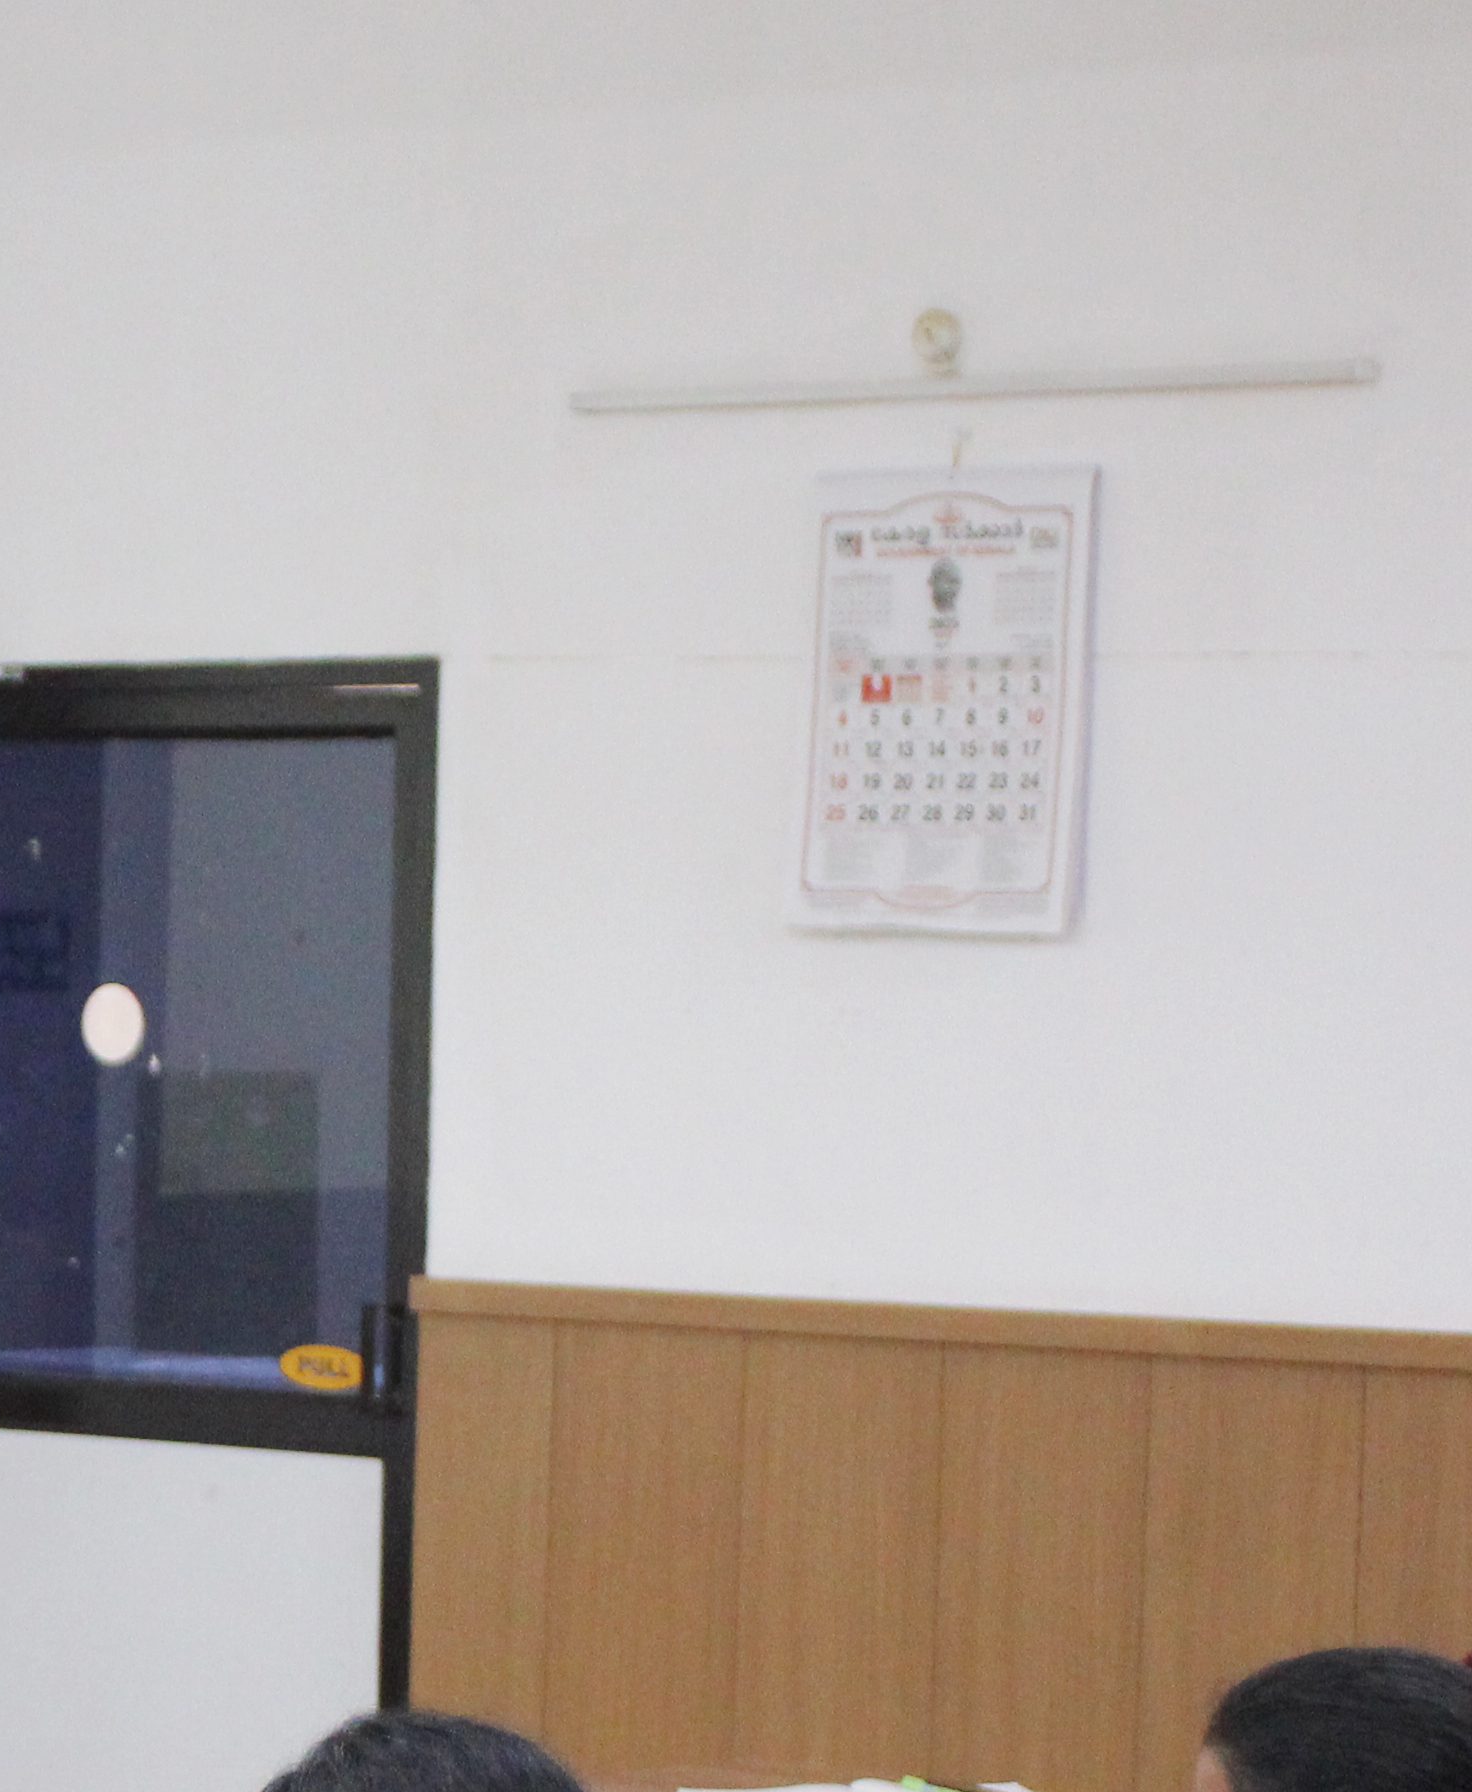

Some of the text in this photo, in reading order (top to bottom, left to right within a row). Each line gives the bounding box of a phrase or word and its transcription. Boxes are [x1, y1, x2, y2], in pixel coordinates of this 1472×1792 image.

[935, 707, 945, 726] 7
[865, 740, 882, 759] 12
[929, 739, 946, 758] 14
[960, 739, 977, 758] 15
[1022, 738, 1042, 758] 17
[863, 772, 882, 791] 19
[925, 772, 946, 791] 21
[957, 772, 977, 790] 22
[989, 771, 1008, 790] 23
[1020, 771, 1040, 790] 24
[858, 803, 879, 822] 26
[891, 803, 911, 822] 27
[922, 802, 943, 822] 28
[954, 802, 975, 822] 29
[1018, 802, 1038, 822] 31
